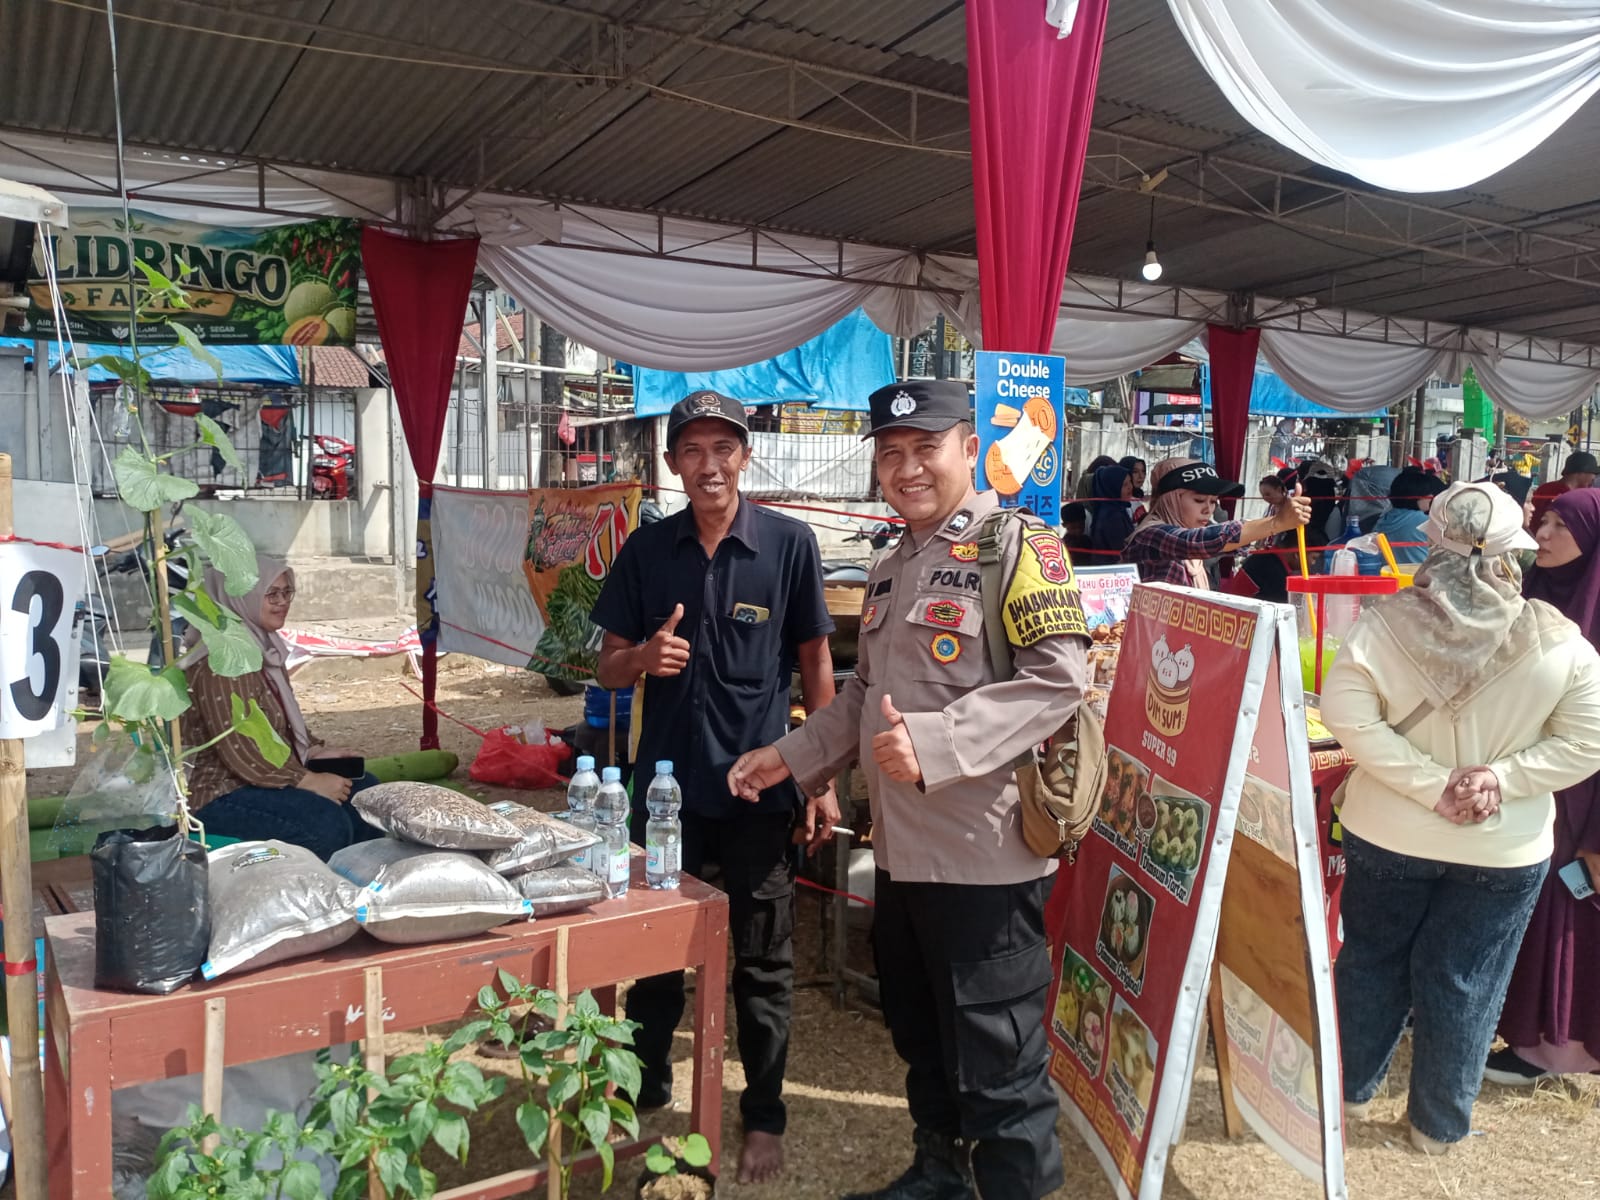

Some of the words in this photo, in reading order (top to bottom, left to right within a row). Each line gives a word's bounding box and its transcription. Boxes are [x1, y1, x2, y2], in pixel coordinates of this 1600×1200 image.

[209, 325, 235, 333] SEGAR
[998, 358, 1050, 379] Double
[996, 379, 1050, 399] Cheese
[1181, 466, 1219, 483] SPO
[1077, 578, 1096, 590] TAHU
[1098, 577, 1131, 589] GEJROT
[1148, 692, 1162, 723] DIM
[1162, 707, 1182, 730] SUM
[1141, 729, 1166, 761] SUPER
[1166, 745, 1178, 768] 99
[1142, 852, 1167, 888] Dimsum
[1096, 940, 1118, 976] Dimsum
